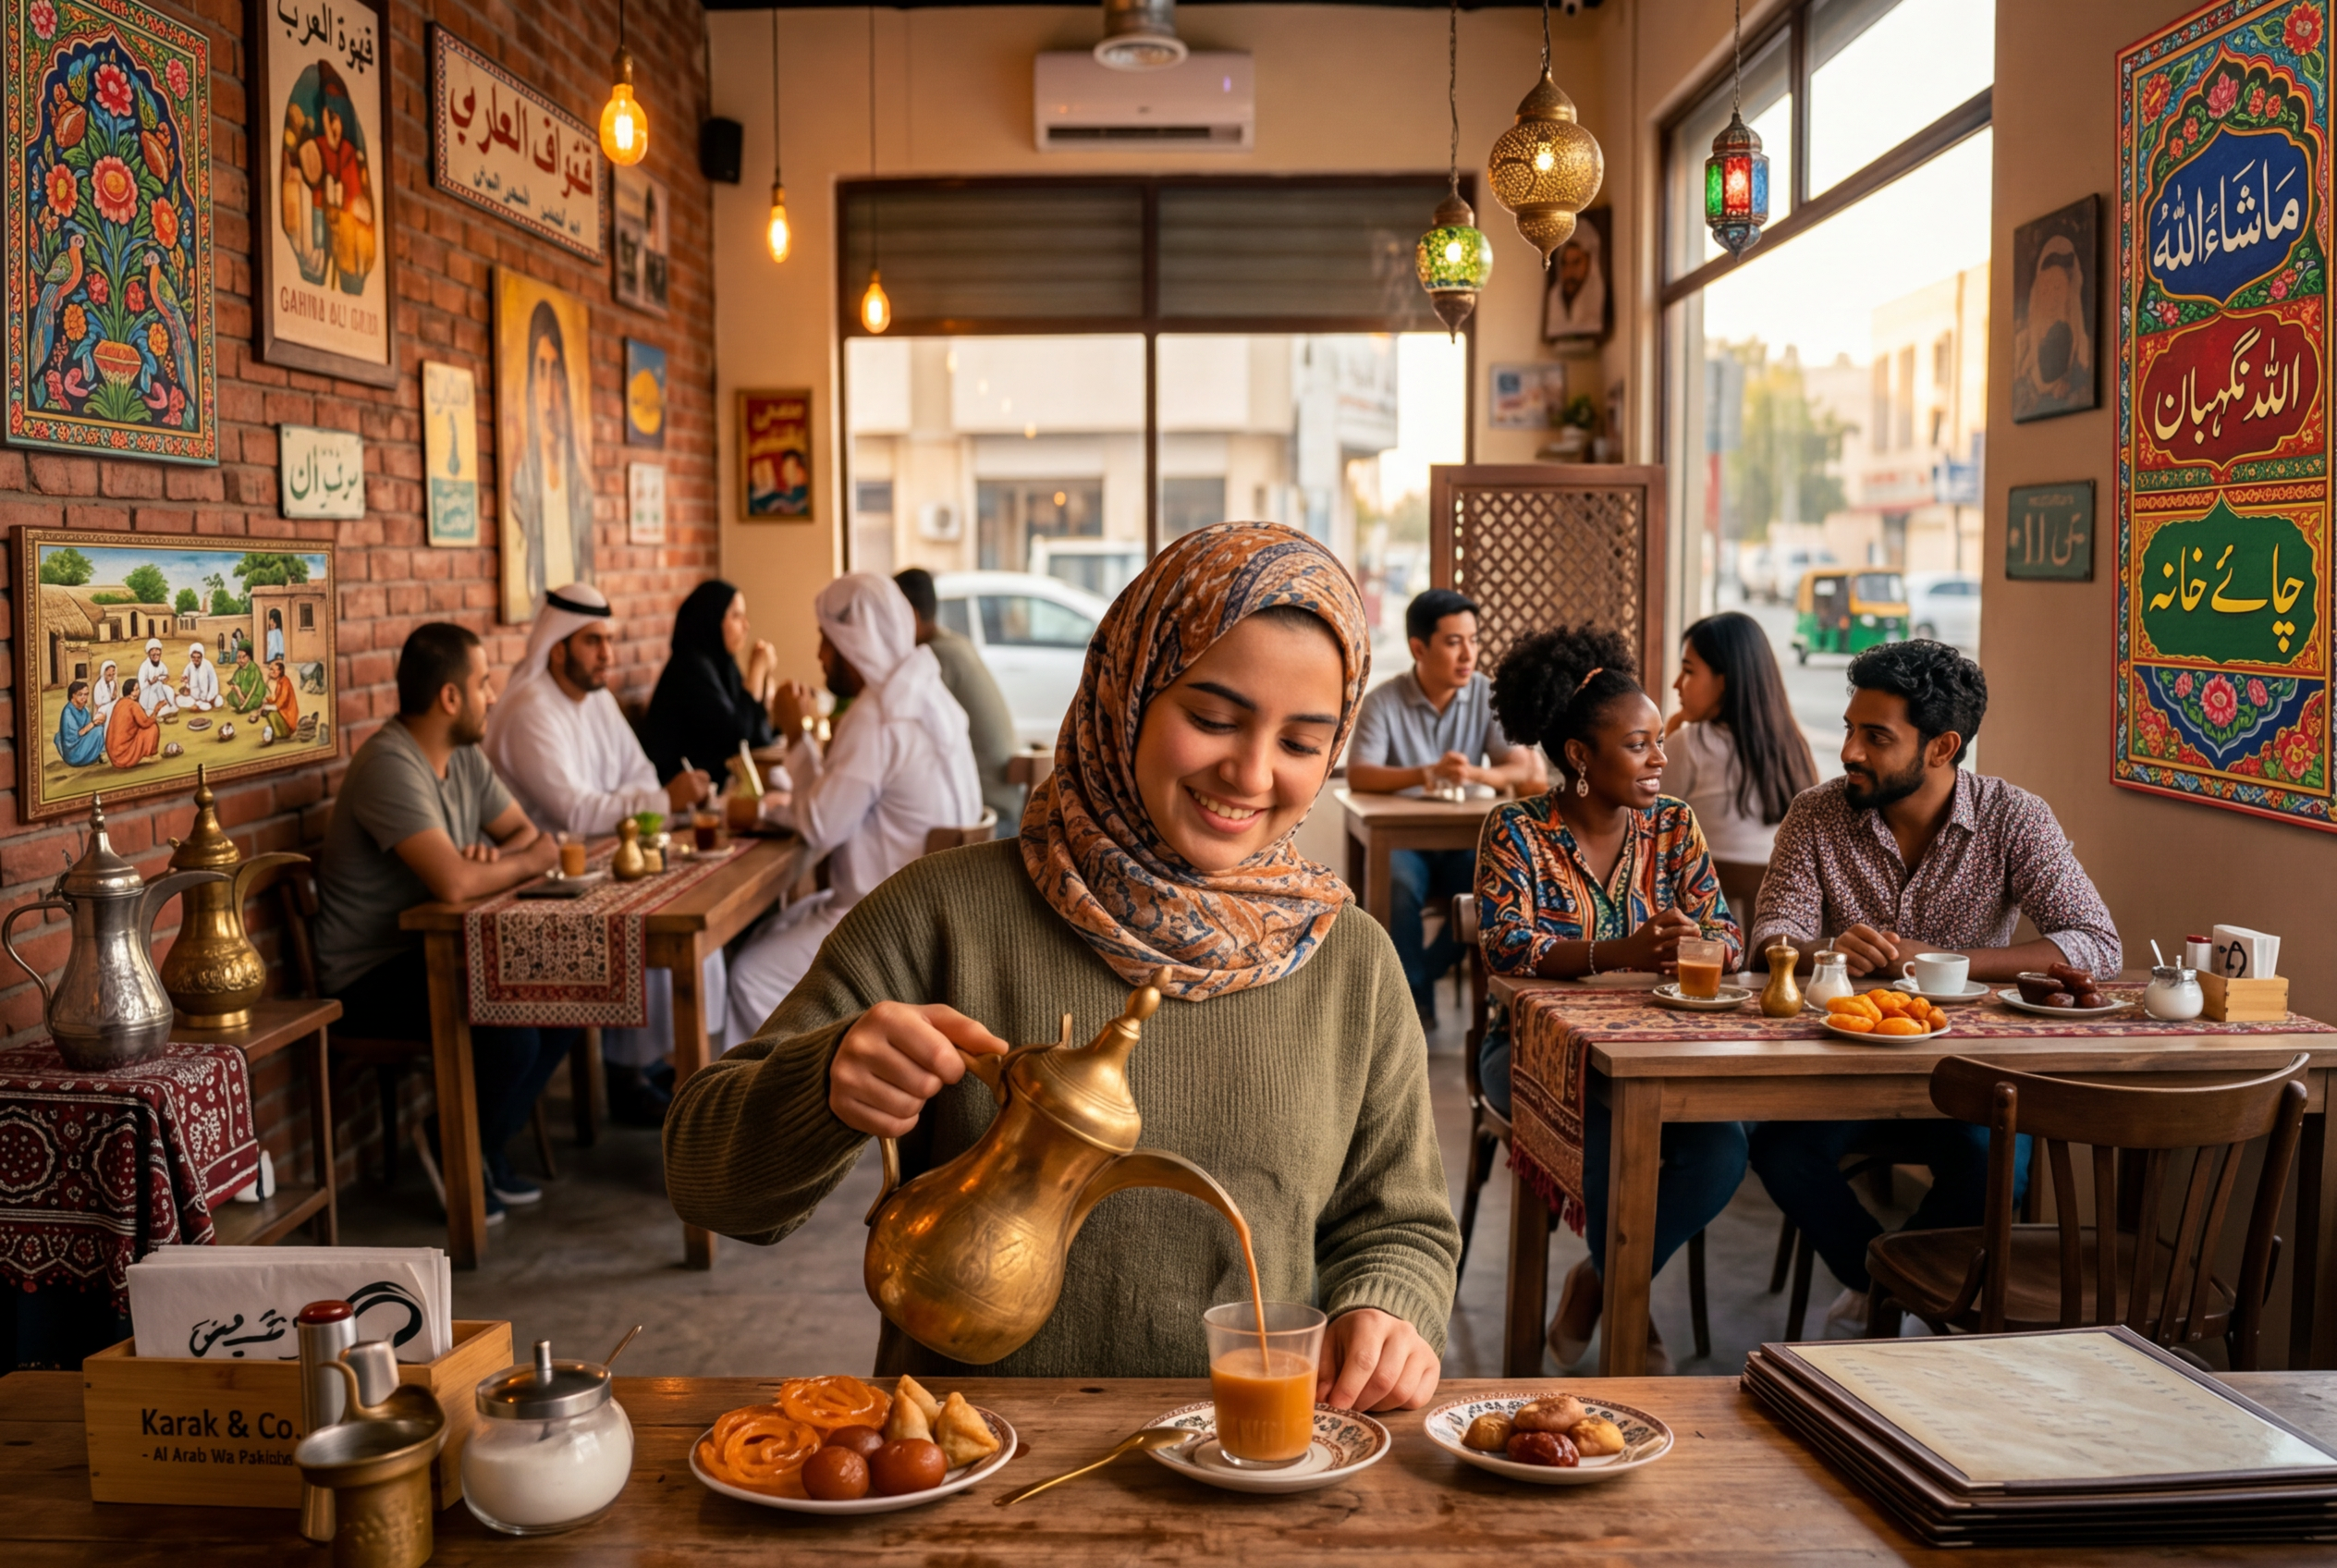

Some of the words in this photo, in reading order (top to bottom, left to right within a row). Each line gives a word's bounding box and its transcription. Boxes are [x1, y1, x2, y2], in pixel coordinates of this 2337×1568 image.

[2148, 545, 2208, 613] خانہ
[141, 1408, 220, 1438] Karak
[227, 1409, 250, 1439] &
[258, 1412, 301, 1439] Co.
[153, 1446, 168, 1462] Al
[172, 1447, 207, 1464] Arab
[210, 1448, 235, 1464] Wa
